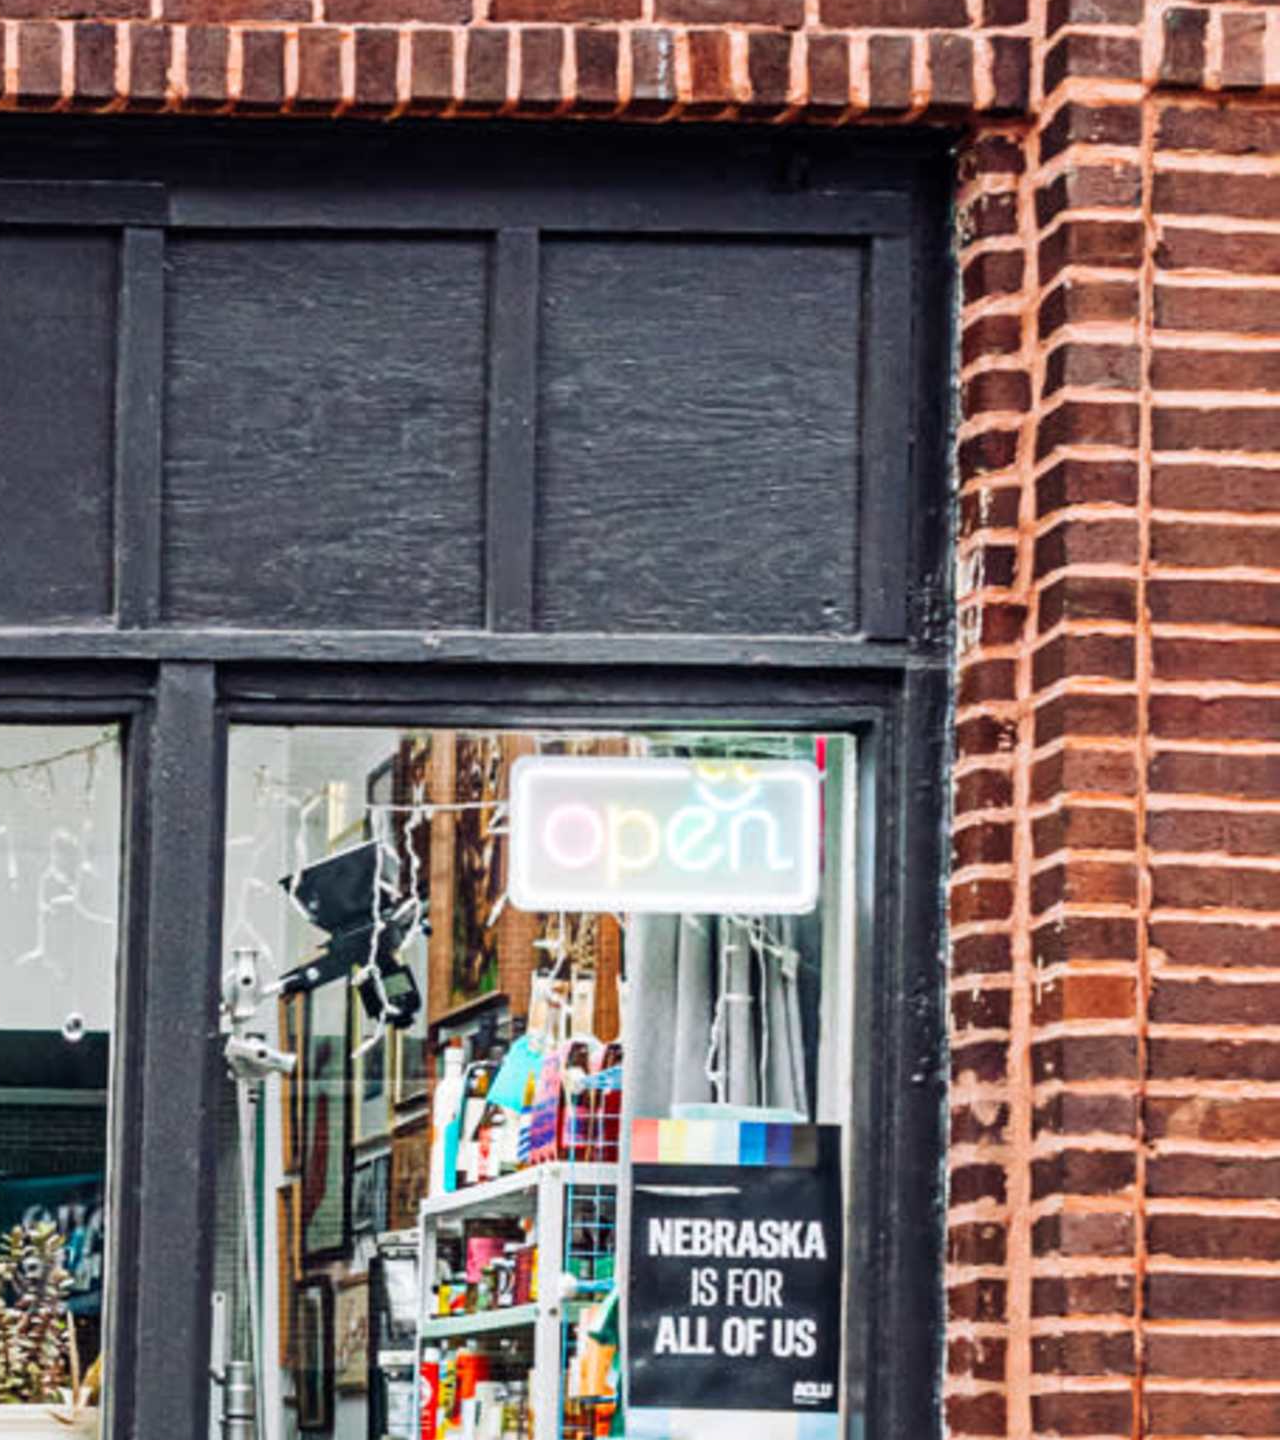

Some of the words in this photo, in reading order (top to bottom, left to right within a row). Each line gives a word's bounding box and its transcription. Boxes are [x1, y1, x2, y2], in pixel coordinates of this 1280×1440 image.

[542, 801, 795, 889] open
[648, 1218, 827, 1258] NEBRASKA
[691, 1267, 718, 1306] IS
[726, 1268, 783, 1307] FOR
[654, 1316, 715, 1354] ALL
[722, 1317, 766, 1357] OF
[772, 1319, 817, 1357] US
